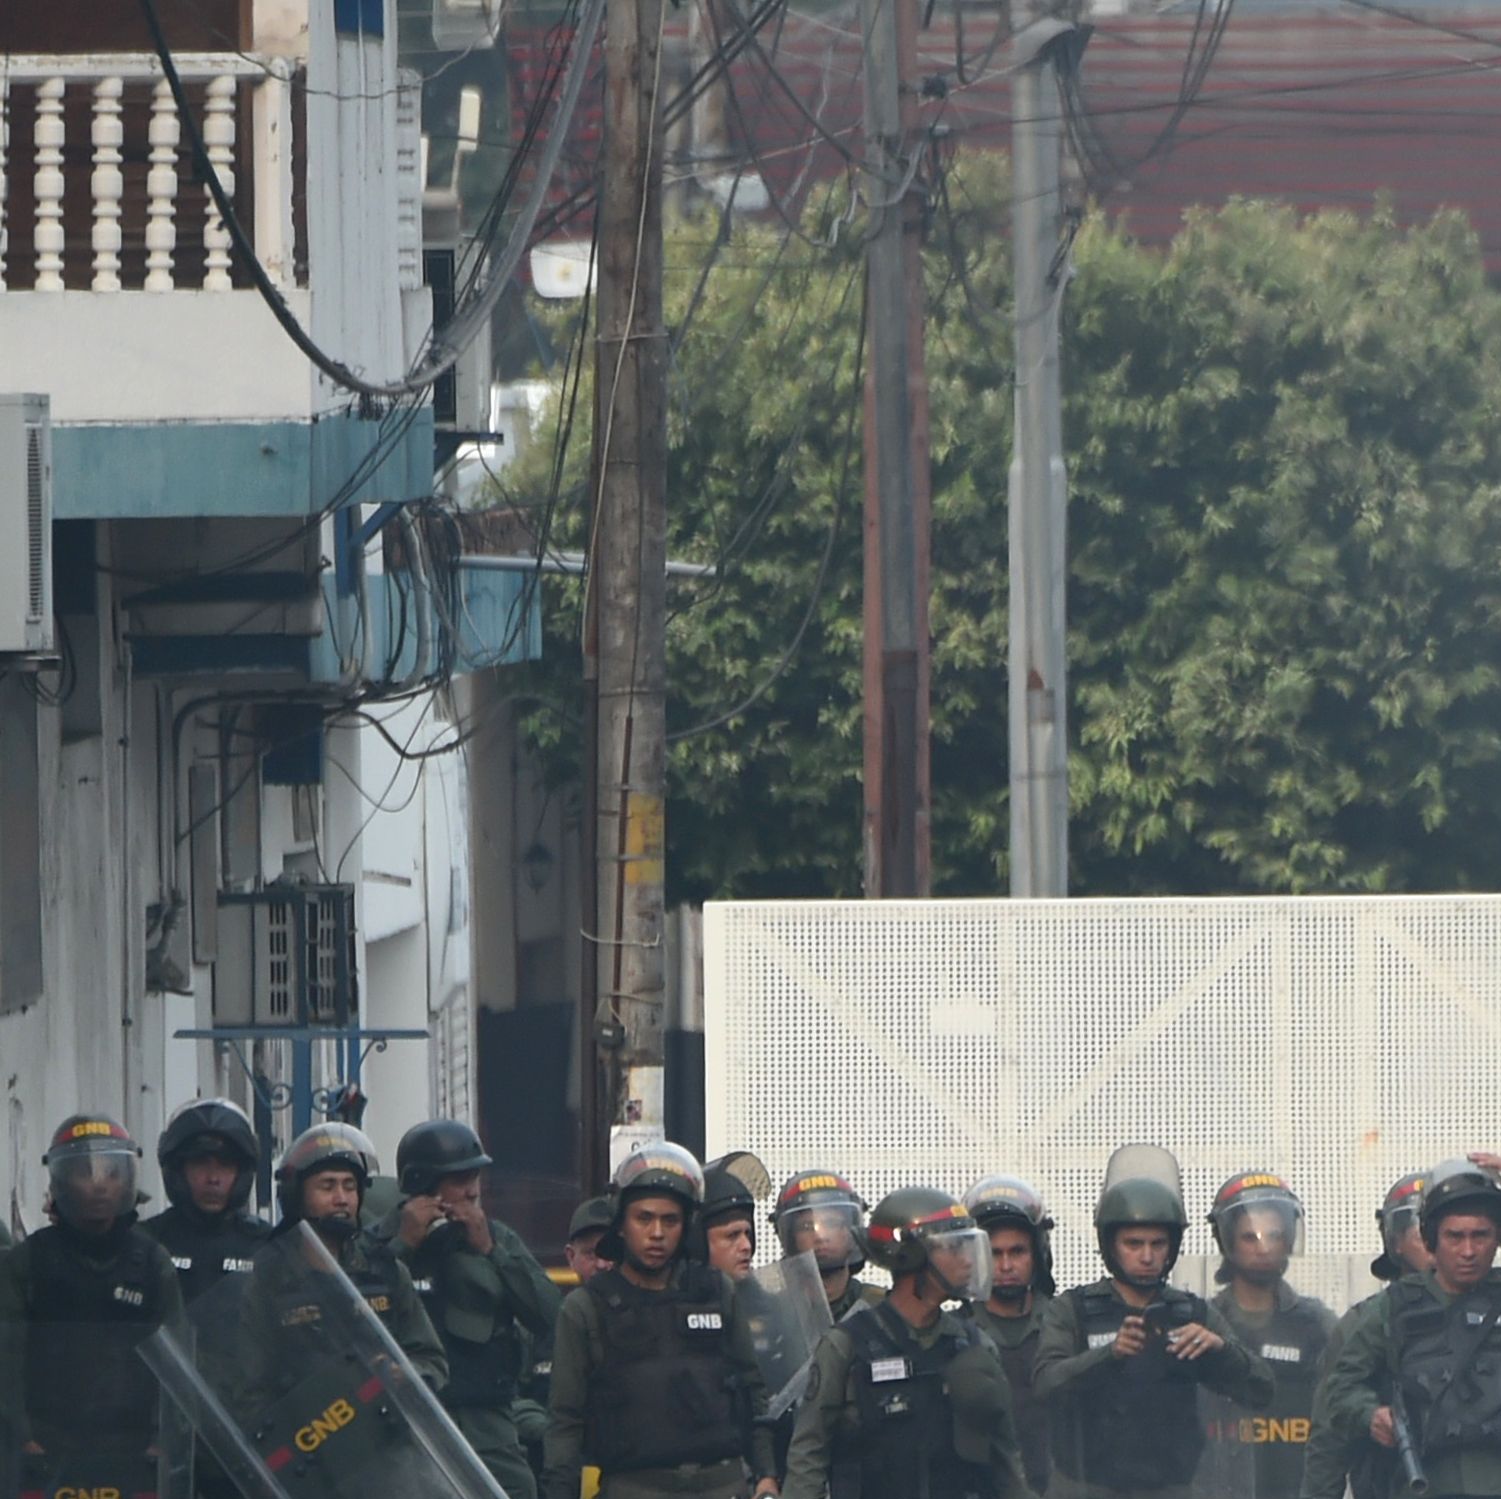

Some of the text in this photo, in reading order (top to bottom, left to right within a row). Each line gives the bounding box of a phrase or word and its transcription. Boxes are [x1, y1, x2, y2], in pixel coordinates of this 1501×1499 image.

[72, 1122, 111, 1137] GNB
[800, 1175, 838, 1191] GNB
[1242, 1175, 1281, 1188] GNB
[113, 1286, 144, 1306] GNB
[688, 1313, 723, 1329] GNB
[1262, 1345, 1300, 1362] FANB
[294, 1398, 356, 1451] GNB
